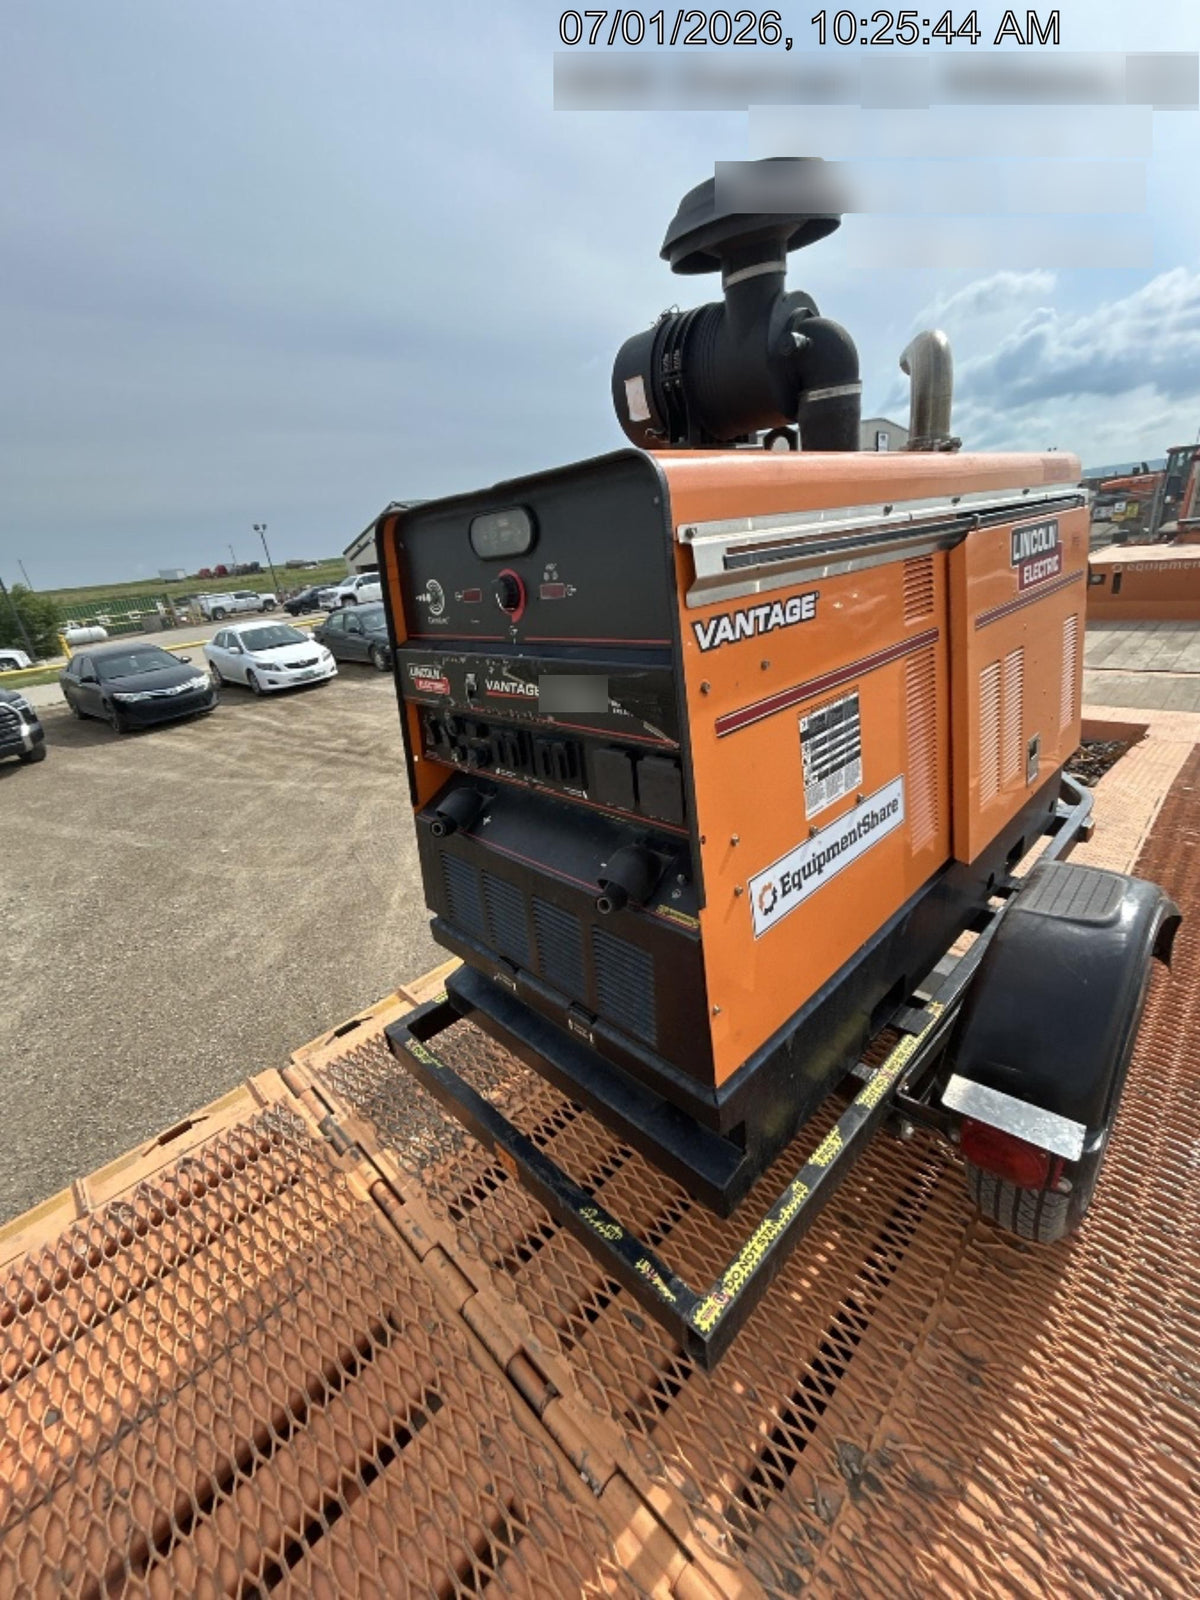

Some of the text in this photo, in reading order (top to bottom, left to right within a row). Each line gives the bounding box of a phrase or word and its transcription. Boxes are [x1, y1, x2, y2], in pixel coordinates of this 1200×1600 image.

[1013, 524, 1057, 561] LINCOLN
[1024, 554, 1059, 585] ELECTRIC
[693, 591, 819, 652] VANTAGE
[779, 798, 899, 898] EquipmentShare
[723, 1269, 741, 1289] DO
[737, 1245, 759, 1270] NOT
